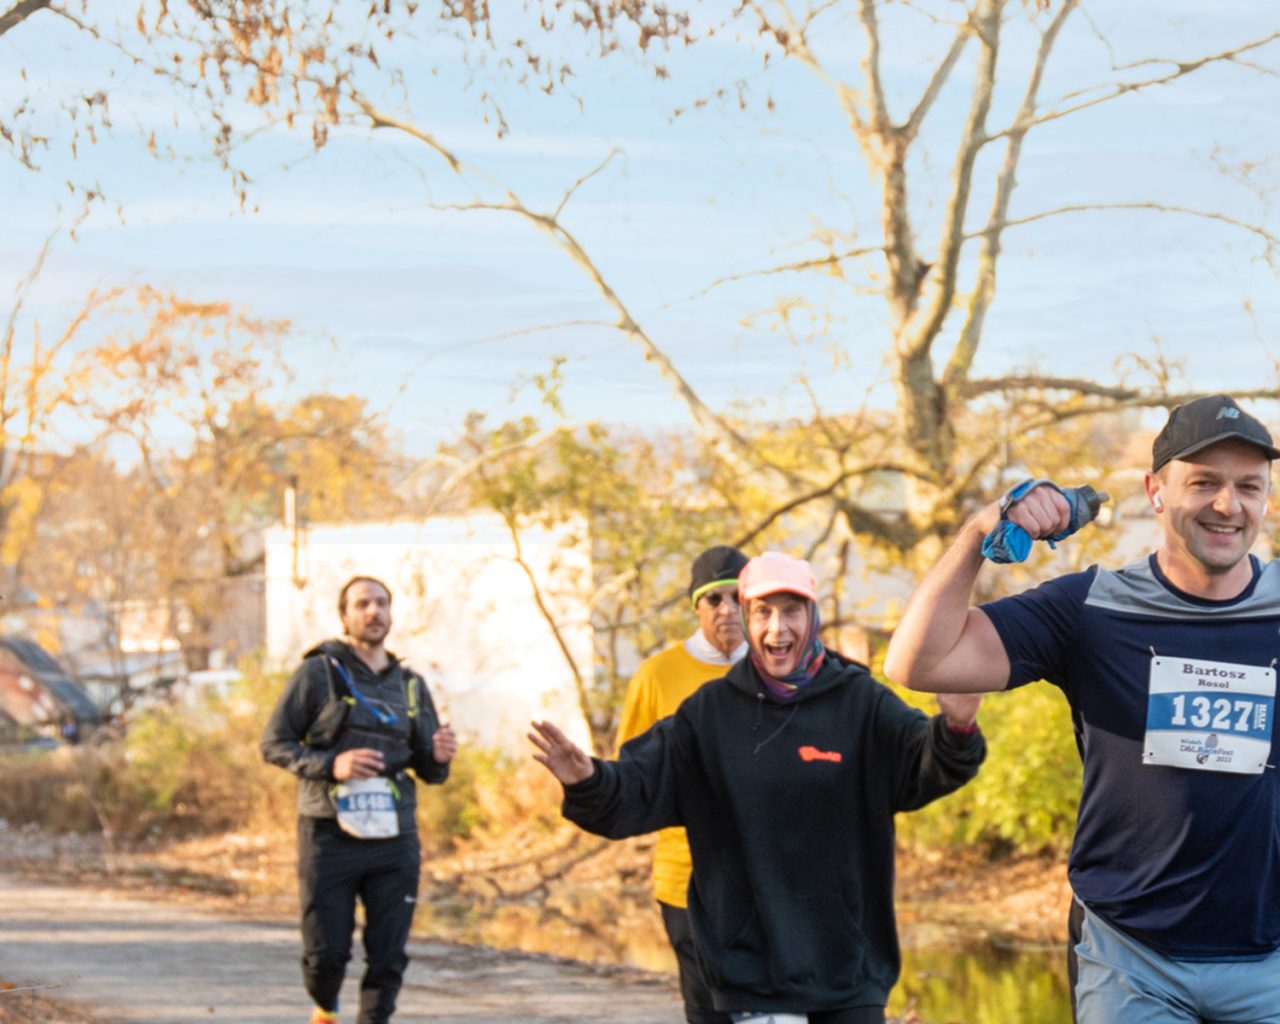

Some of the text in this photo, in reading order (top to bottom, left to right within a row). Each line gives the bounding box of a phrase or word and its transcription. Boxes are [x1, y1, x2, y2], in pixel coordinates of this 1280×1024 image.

[1182, 664, 1246, 680] Bartosz
[1198, 679, 1230, 689] Rosol
[1171, 694, 1253, 731] 1327
